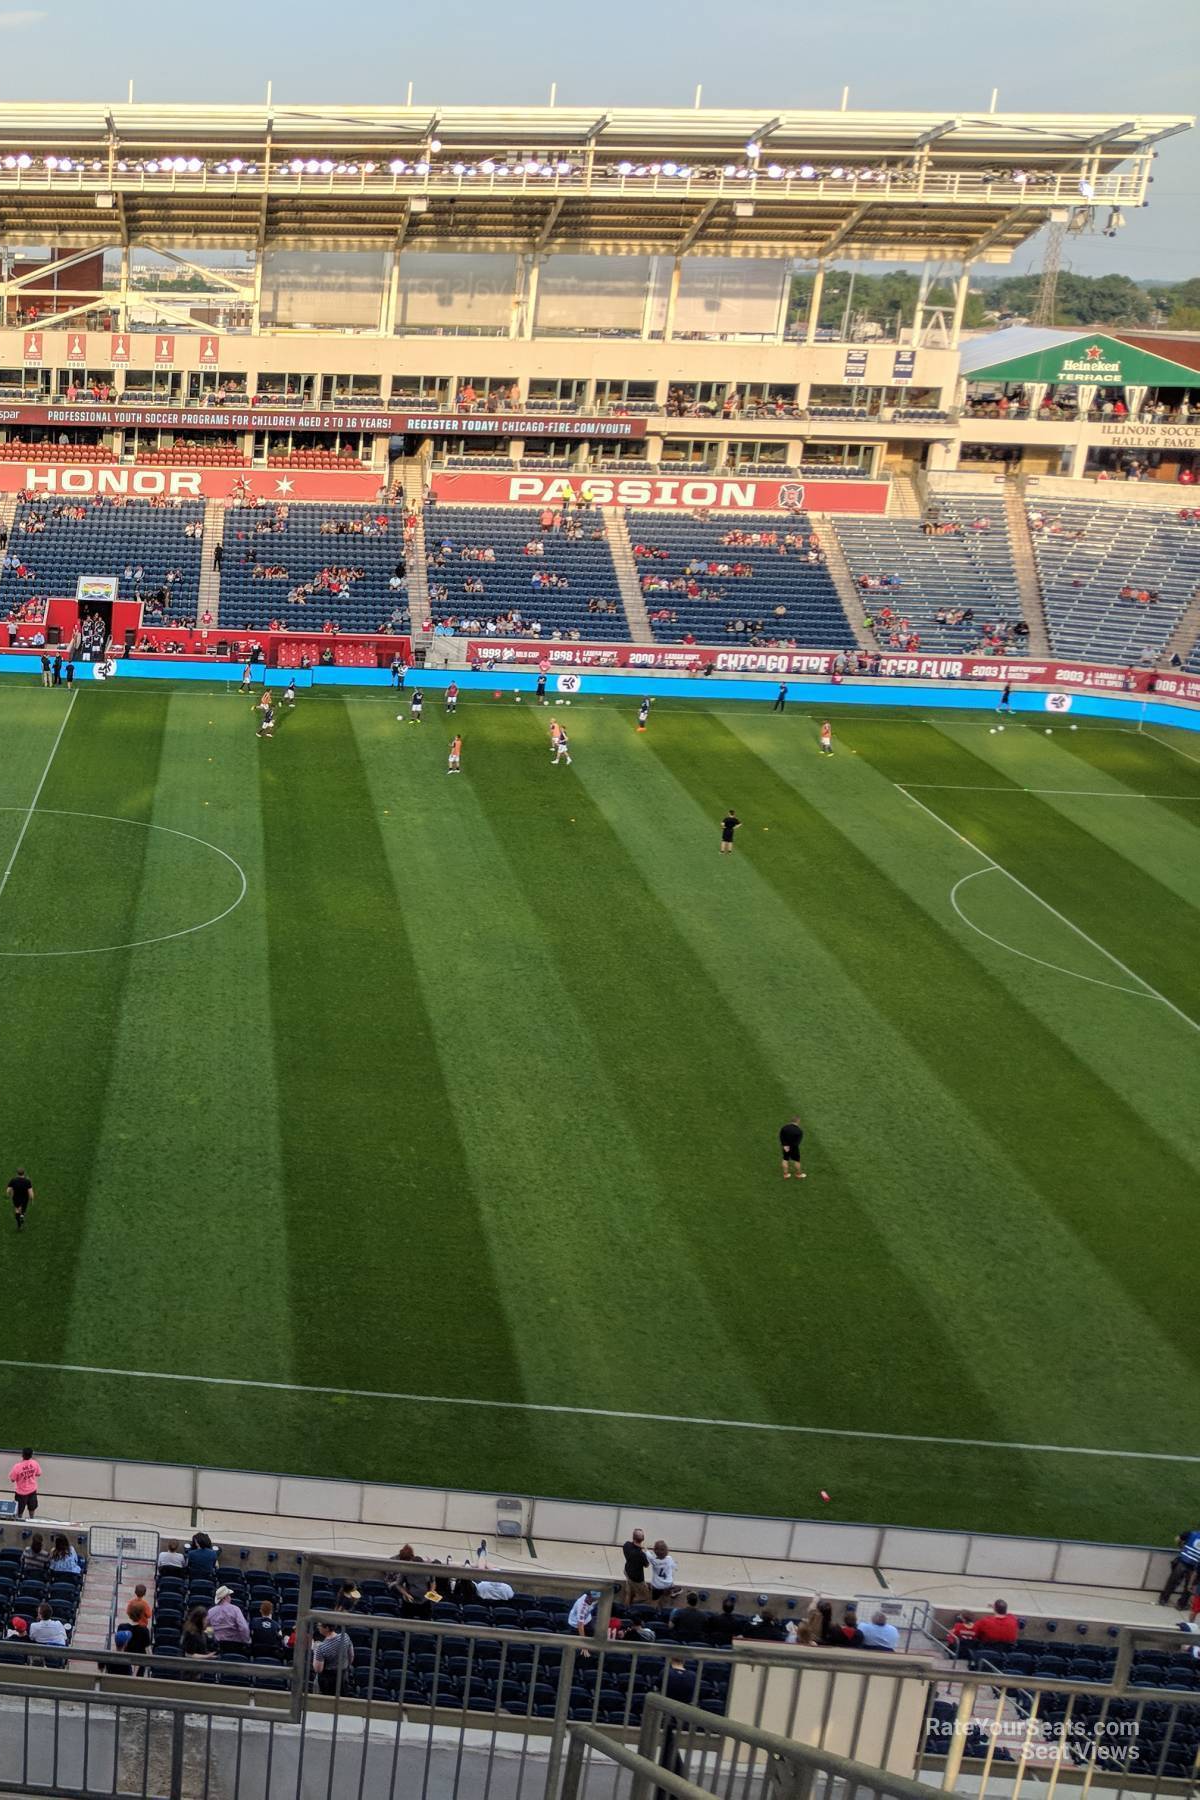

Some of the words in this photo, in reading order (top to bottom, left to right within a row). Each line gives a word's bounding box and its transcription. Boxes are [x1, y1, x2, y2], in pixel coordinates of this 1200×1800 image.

[1063, 360, 1120, 371] Heineken
[1057, 373, 1122, 382] TERRACE
[48, 411, 112, 423] PROFESSIONAL
[114, 412, 142, 424] YOUTH
[145, 413, 178, 425] SOCCER
[181, 414, 229, 426] PROGRAMS
[232, 415, 249, 426] FOR
[251, 415, 296, 427] CHILDREN
[299, 416, 321, 427] AGED
[323, 417, 330, 428] 2
[332, 417, 343, 428] TO
[346, 417, 357, 428] 16
[360, 417, 392, 429] YEARS!
[407, 418, 458, 431] REGISTER
[462, 419, 498, 432] TODAY!
[502, 420, 632, 434] CHICAGO-FIRE.COM/YOUTH
[1101, 425, 1156, 435] ILLINOIS
[1112, 437, 1144, 446] HALL
[1147, 437, 1159, 447] of
[1163, 438, 1196, 448] FAME
[26, 468, 202, 495] HONOR
[509, 477, 756, 508] PASSION
[478, 648, 501, 658] 1998
[548, 650, 573, 662] 1998
[629, 653, 655, 665] 2000
[717, 653, 789, 673] CHICAGO
[792, 655, 830, 674] FIRE
[866, 658, 918, 676] CCER
[920, 660, 963, 678] CLUB
[972, 666, 999, 677] 2003
[1055, 669, 1085, 682] 2003
[1153, 679, 1177, 692] 006
[658, 1568, 667, 1580] 4
